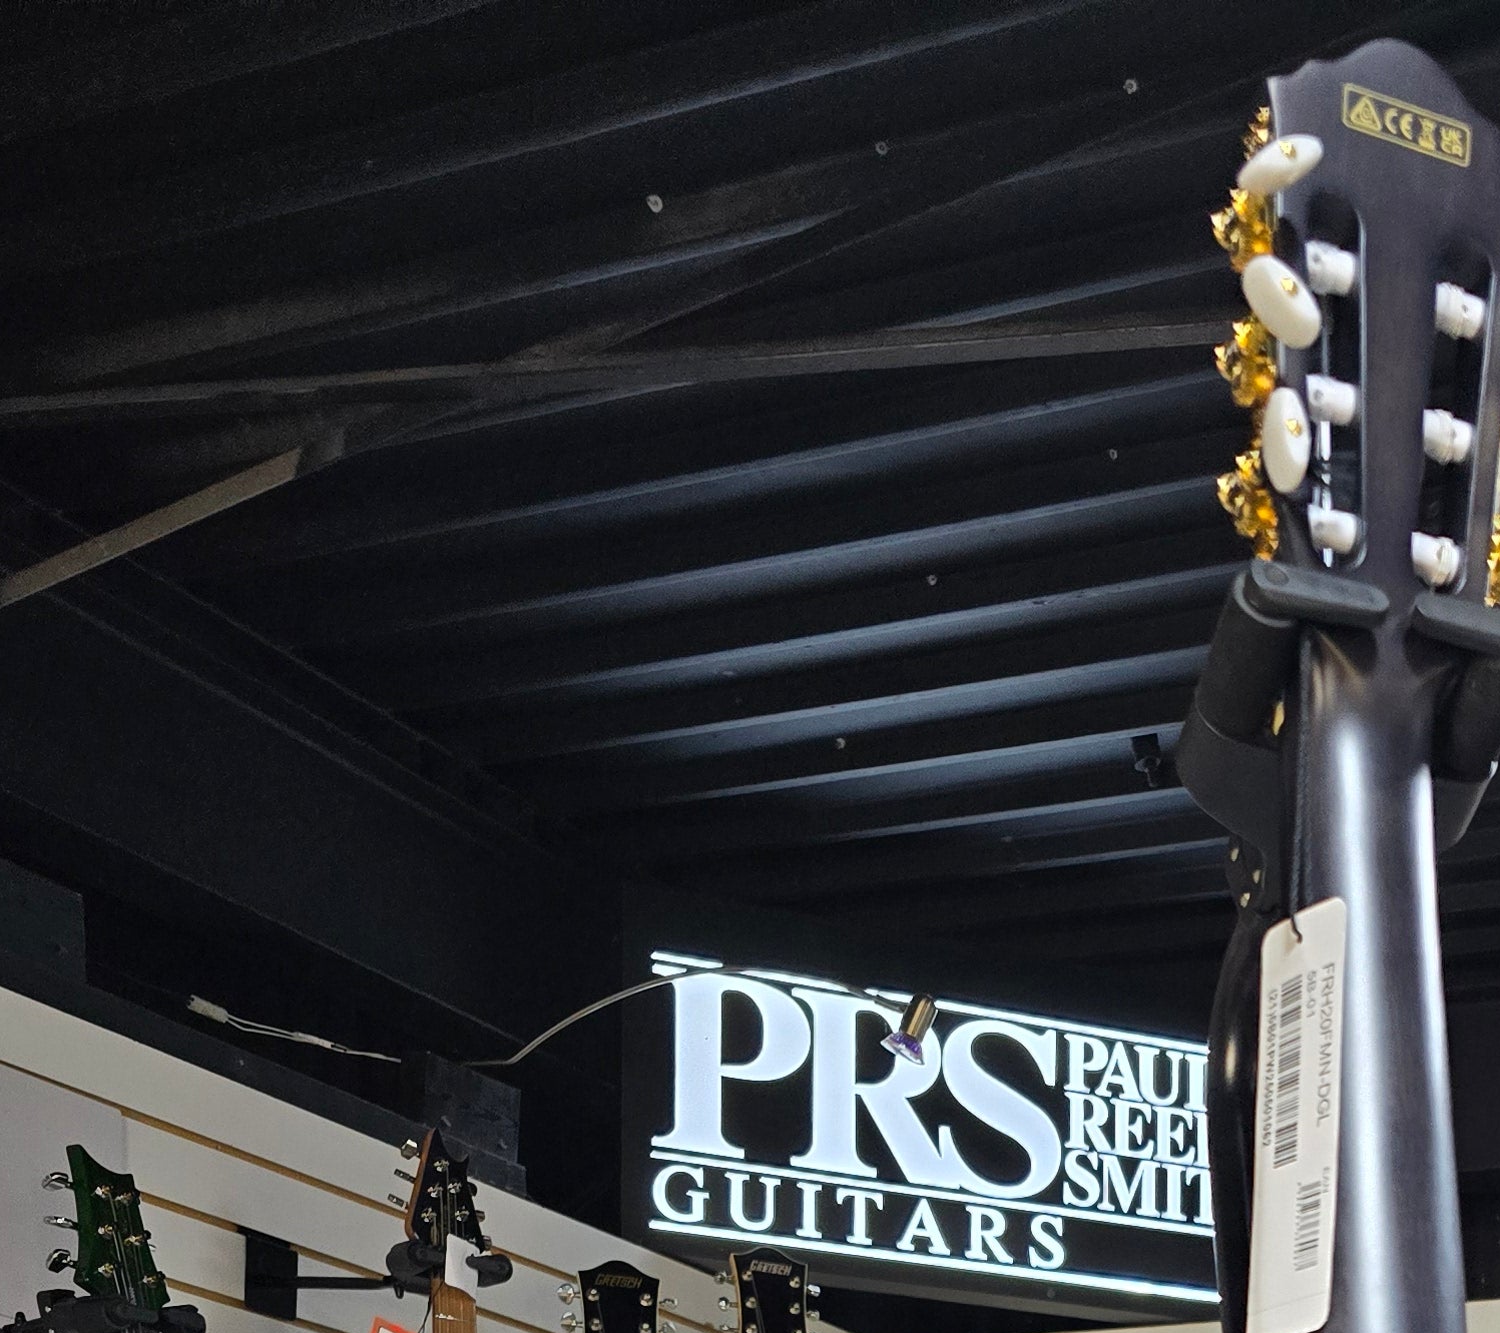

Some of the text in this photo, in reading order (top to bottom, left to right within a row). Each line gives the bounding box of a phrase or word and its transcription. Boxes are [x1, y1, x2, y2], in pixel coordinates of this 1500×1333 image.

[651, 970, 1063, 1200] PRS
[1316, 962, 1335, 1128] FRH20FMN-DGL
[651, 1165, 1066, 1269] GUITARS
[1063, 1149, 1216, 1226] SMIT
[595, 1273, 643, 1289] GRETSCH
[751, 1259, 792, 1276] GRETSCH
